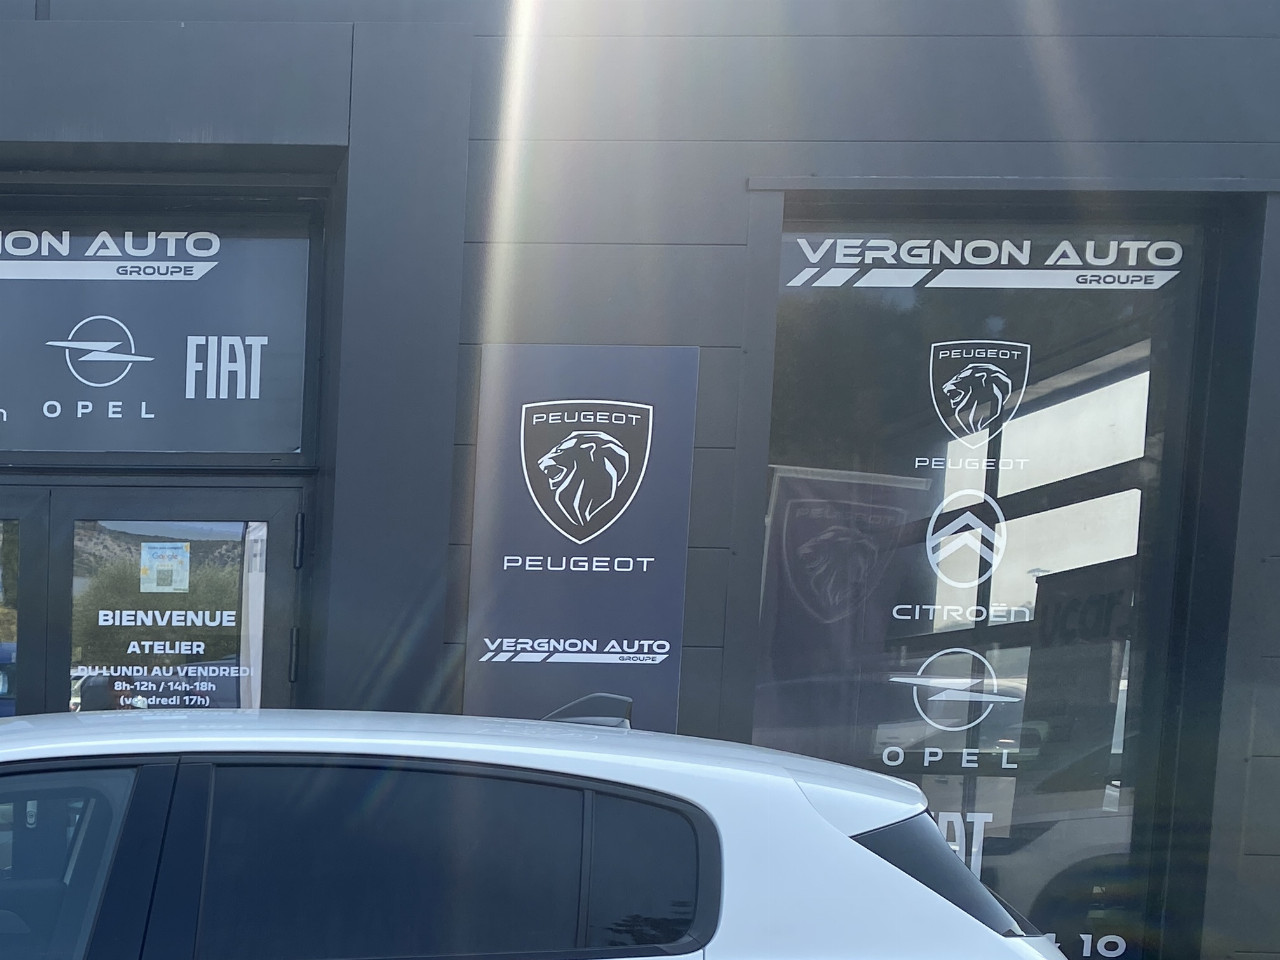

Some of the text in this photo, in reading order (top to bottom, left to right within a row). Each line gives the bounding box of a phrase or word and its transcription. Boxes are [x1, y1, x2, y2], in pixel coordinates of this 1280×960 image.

[84, 231, 222, 258] AUTO
[797, 238, 1184, 267] VERGNON AUTO
[116, 264, 195, 277] GROUPE
[1075, 273, 1156, 286] GROUPE
[939, 348, 1022, 360] PEUGEOT
[185, 335, 269, 400] FIAT
[42, 400, 155, 420] OPEL
[532, 411, 641, 426] PEUGEOT
[914, 456, 1030, 471] PEUGEOT
[152, 551, 178, 561] Google
[503, 556, 655, 572] PEUGEOT
[98, 610, 237, 627] BIENVENUE
[127, 641, 206, 655] ATELIER
[484, 638, 671, 653] VERGNON AUTO
[77, 666, 254, 677] DU LUNDI AU VENDREDI
[114, 681, 157, 692] 8h-12h
[168, 681, 216, 692] 14h-18h
[183, 695, 210, 707] 17h)
[882, 746, 1018, 769] OPEL
[1079, 933, 1127, 958] 10
